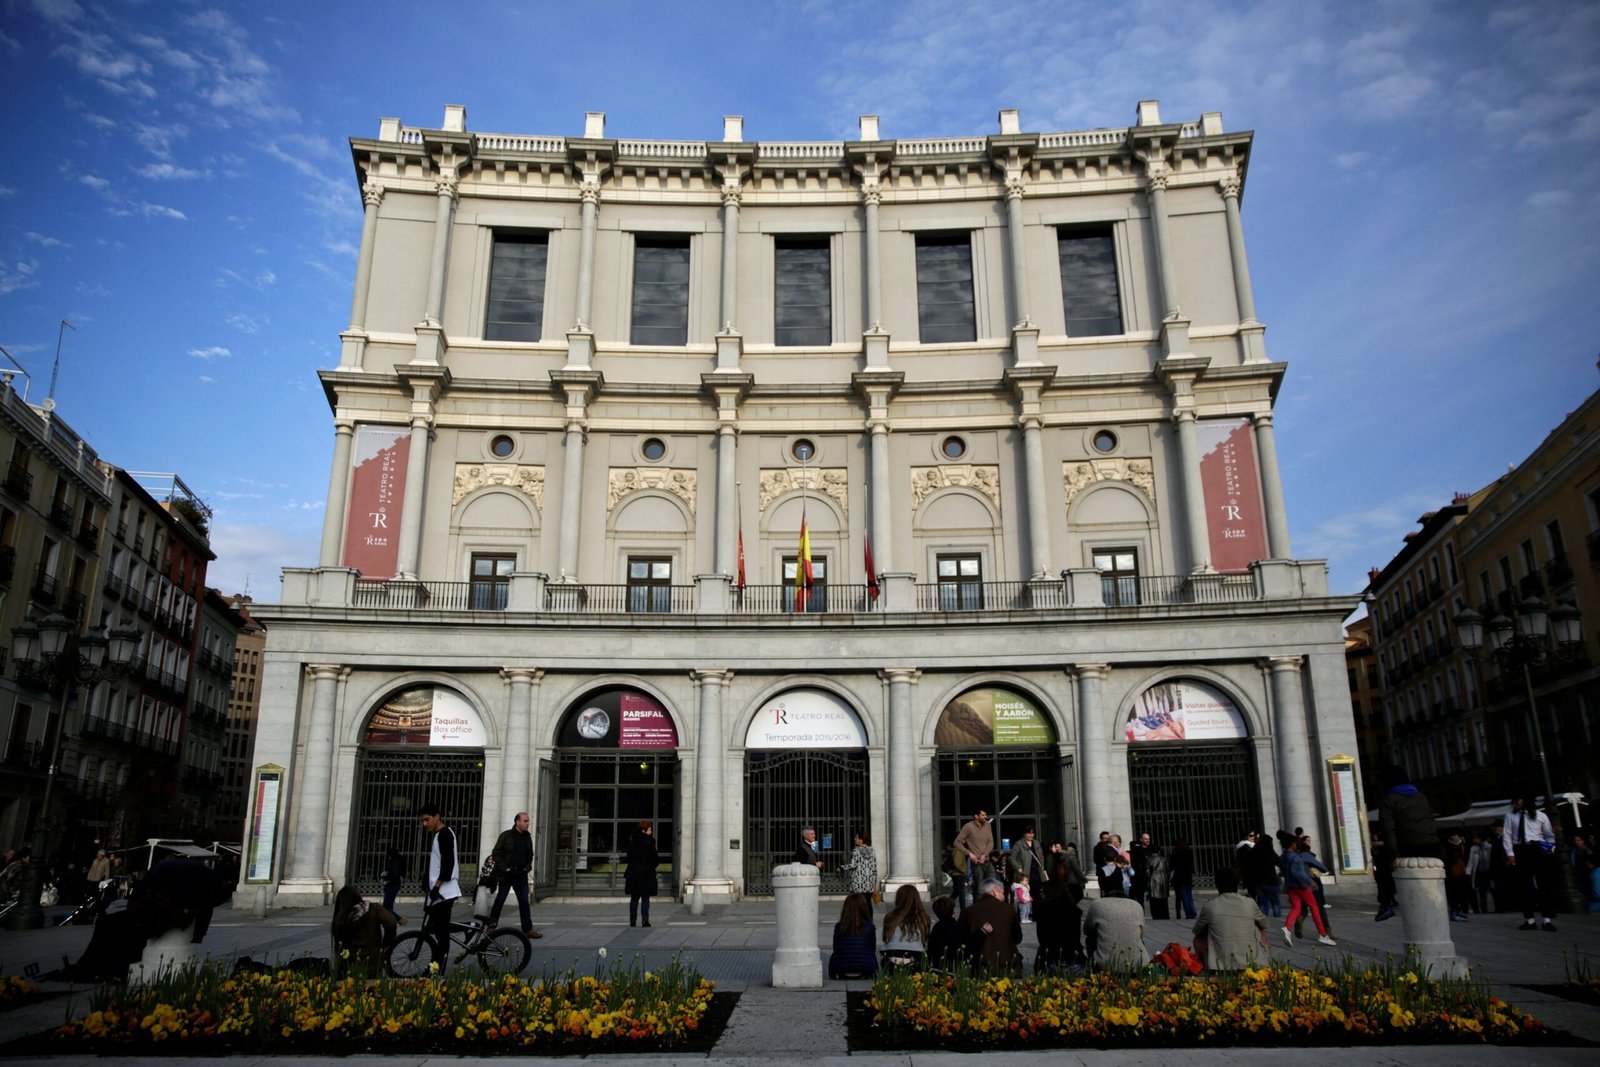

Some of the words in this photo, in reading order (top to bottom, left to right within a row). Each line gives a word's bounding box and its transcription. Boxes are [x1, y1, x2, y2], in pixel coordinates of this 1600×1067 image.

[383, 451, 391, 471] REAL
[379, 473, 388, 503] TEATRO
[1225, 466, 1234, 495] TEATRO
[1003, 708, 1034, 716] AARÓN
[434, 717, 468, 725] Taquillas
[765, 733, 813, 743] Temporada
